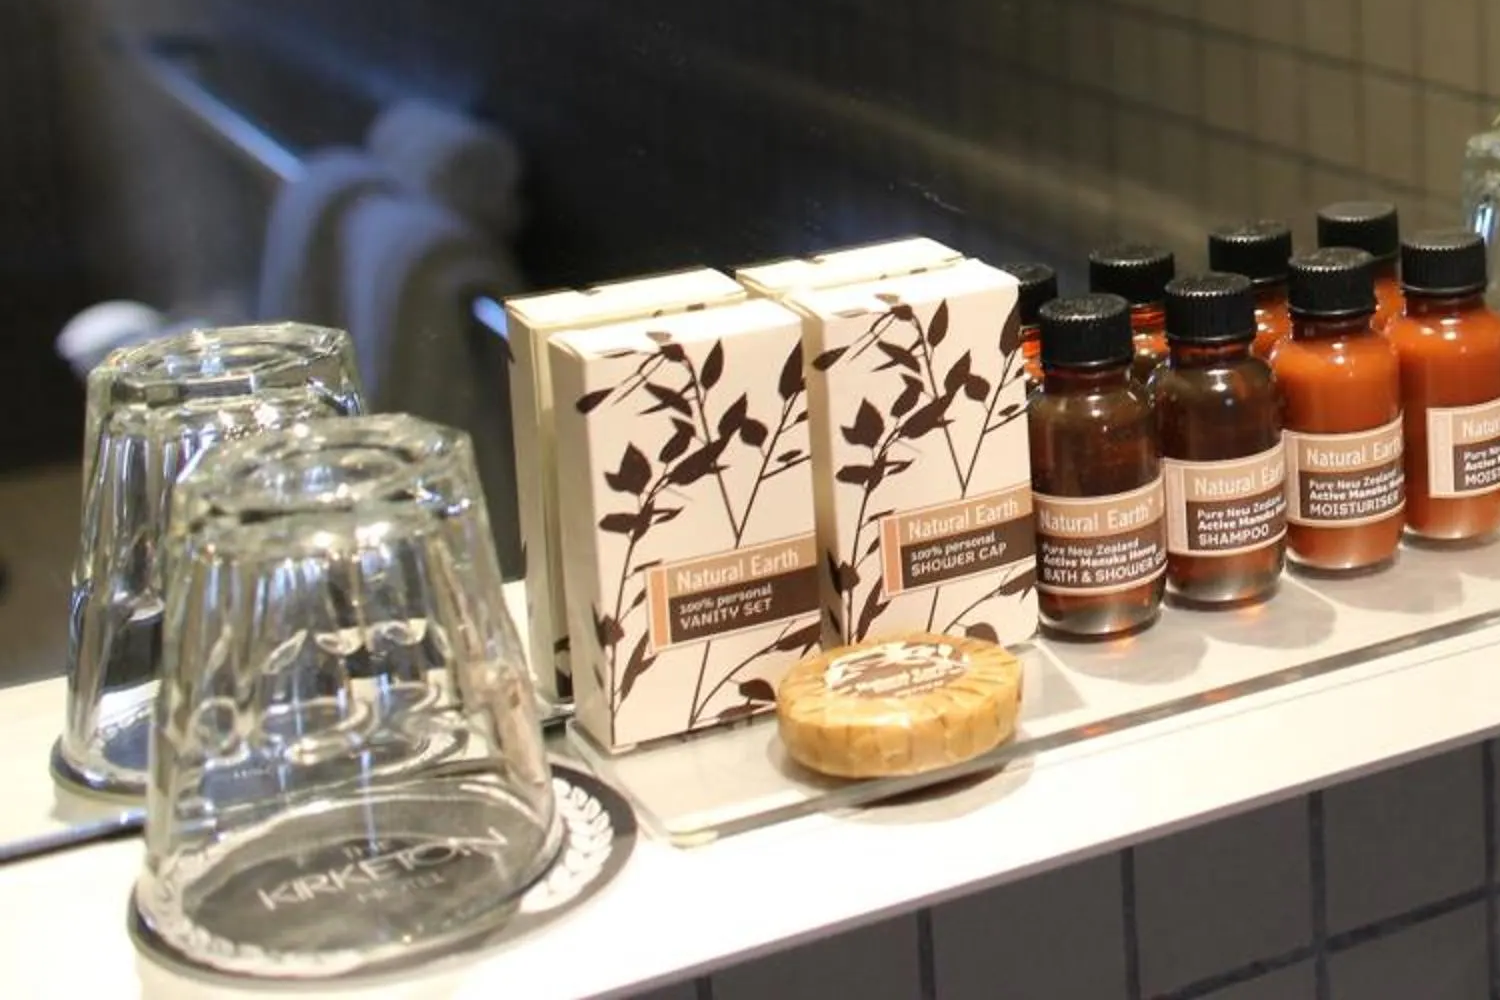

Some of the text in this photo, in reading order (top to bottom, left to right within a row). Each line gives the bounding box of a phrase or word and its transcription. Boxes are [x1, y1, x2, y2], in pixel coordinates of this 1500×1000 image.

[1306, 443, 1366, 468] Natural
[1194, 472, 1256, 497] Natural
[1308, 478, 1335, 491] Pure
[1337, 478, 1361, 490] New
[1309, 489, 1347, 501] Active
[908, 498, 1019, 541] Natural Earth
[1040, 503, 1150, 533] Natural Earth
[1197, 508, 1225, 520] Pure
[1226, 505, 1251, 518] New
[1197, 519, 1237, 532] Active
[911, 529, 996, 562] 100% personal
[1042, 537, 1139, 557] Pure New Zealand
[1198, 523, 1270, 547] SHAMPOO
[676, 548, 800, 594] Natural Earth
[911, 542, 1008, 577] SHOWER CAP
[1043, 553, 1078, 568] Active
[1080, 552, 1128, 568] Manuka
[1043, 566, 1078, 584] BATH
[1081, 569, 1092, 584] &
[1095, 556, 1154, 583] SHOWER
[679, 581, 773, 616] 100% personal
[679, 597, 773, 631] VANITY SET
[257, 826, 508, 911] KIRKETON
